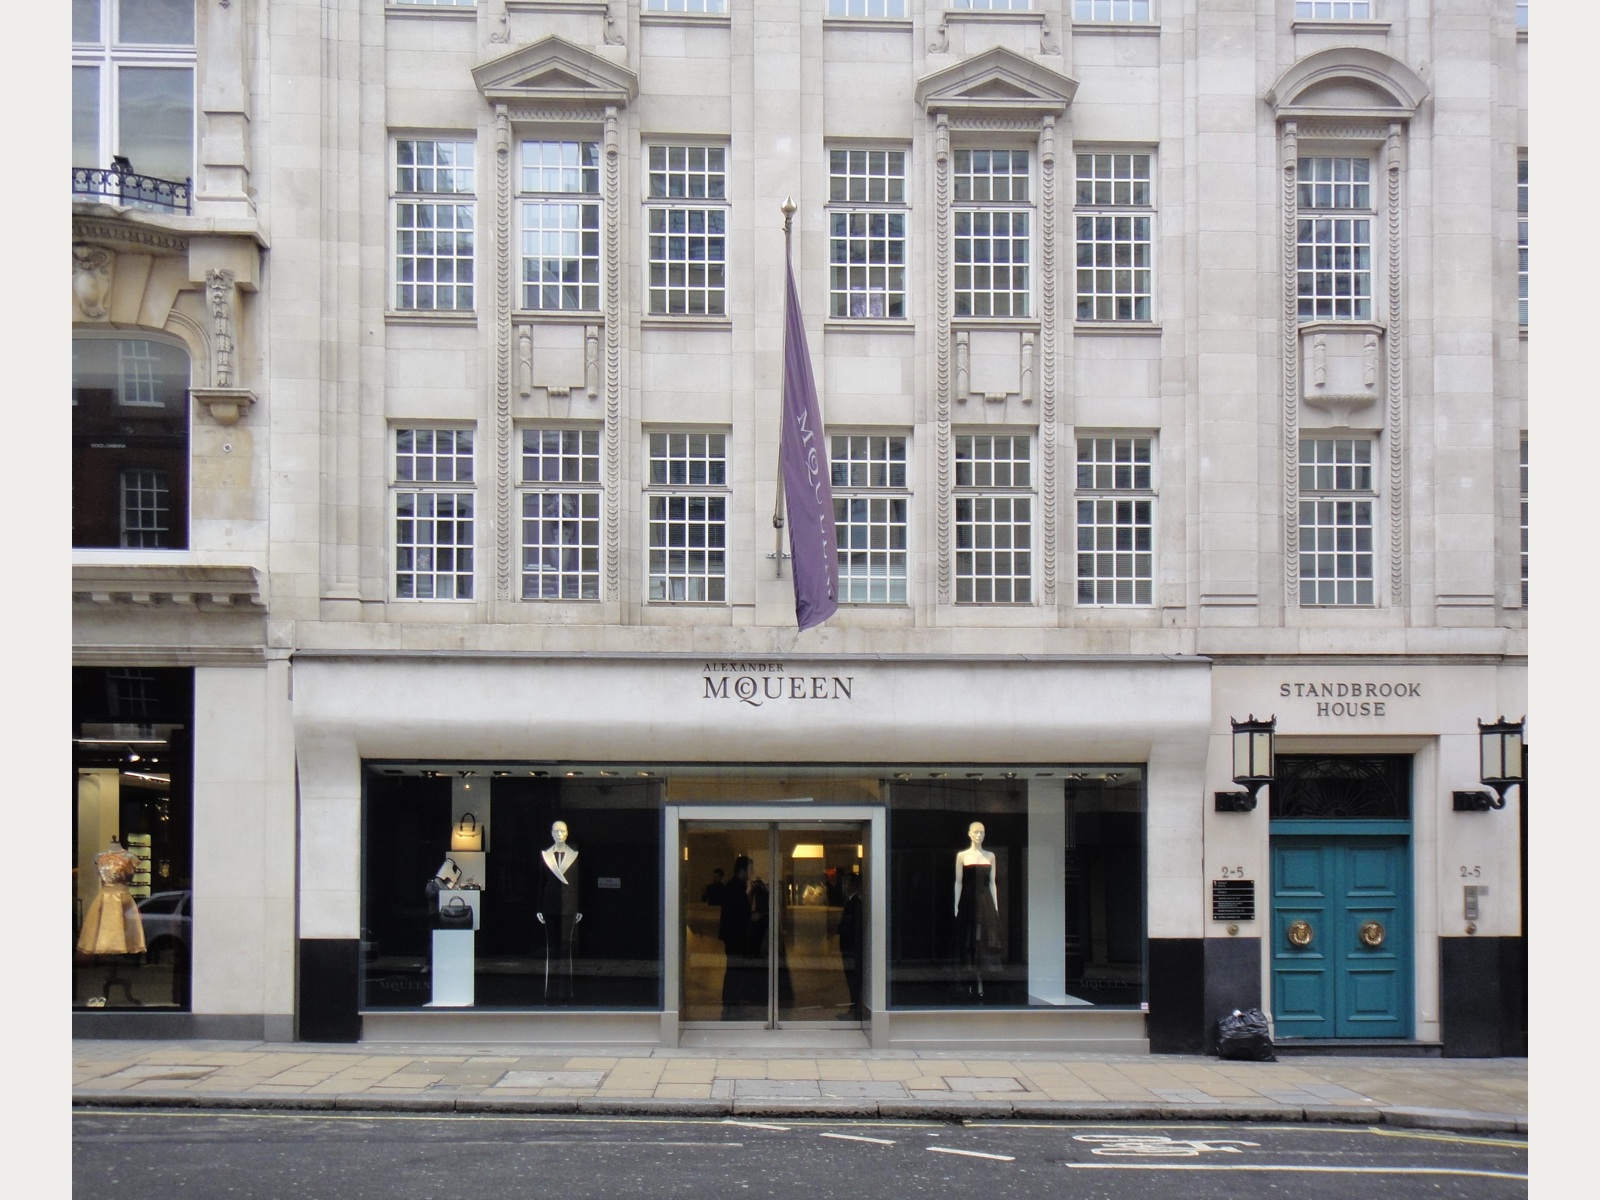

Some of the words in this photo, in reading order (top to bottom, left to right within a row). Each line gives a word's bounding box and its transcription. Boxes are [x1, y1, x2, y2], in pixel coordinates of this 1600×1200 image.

[703, 663, 784, 672] ALEXANDER
[1280, 683, 1421, 697] STANDBROOK
[1317, 702, 1386, 717] HOUSE
[1221, 866, 1244, 879] 2-5
[1459, 865, 1482, 878] 2-5
